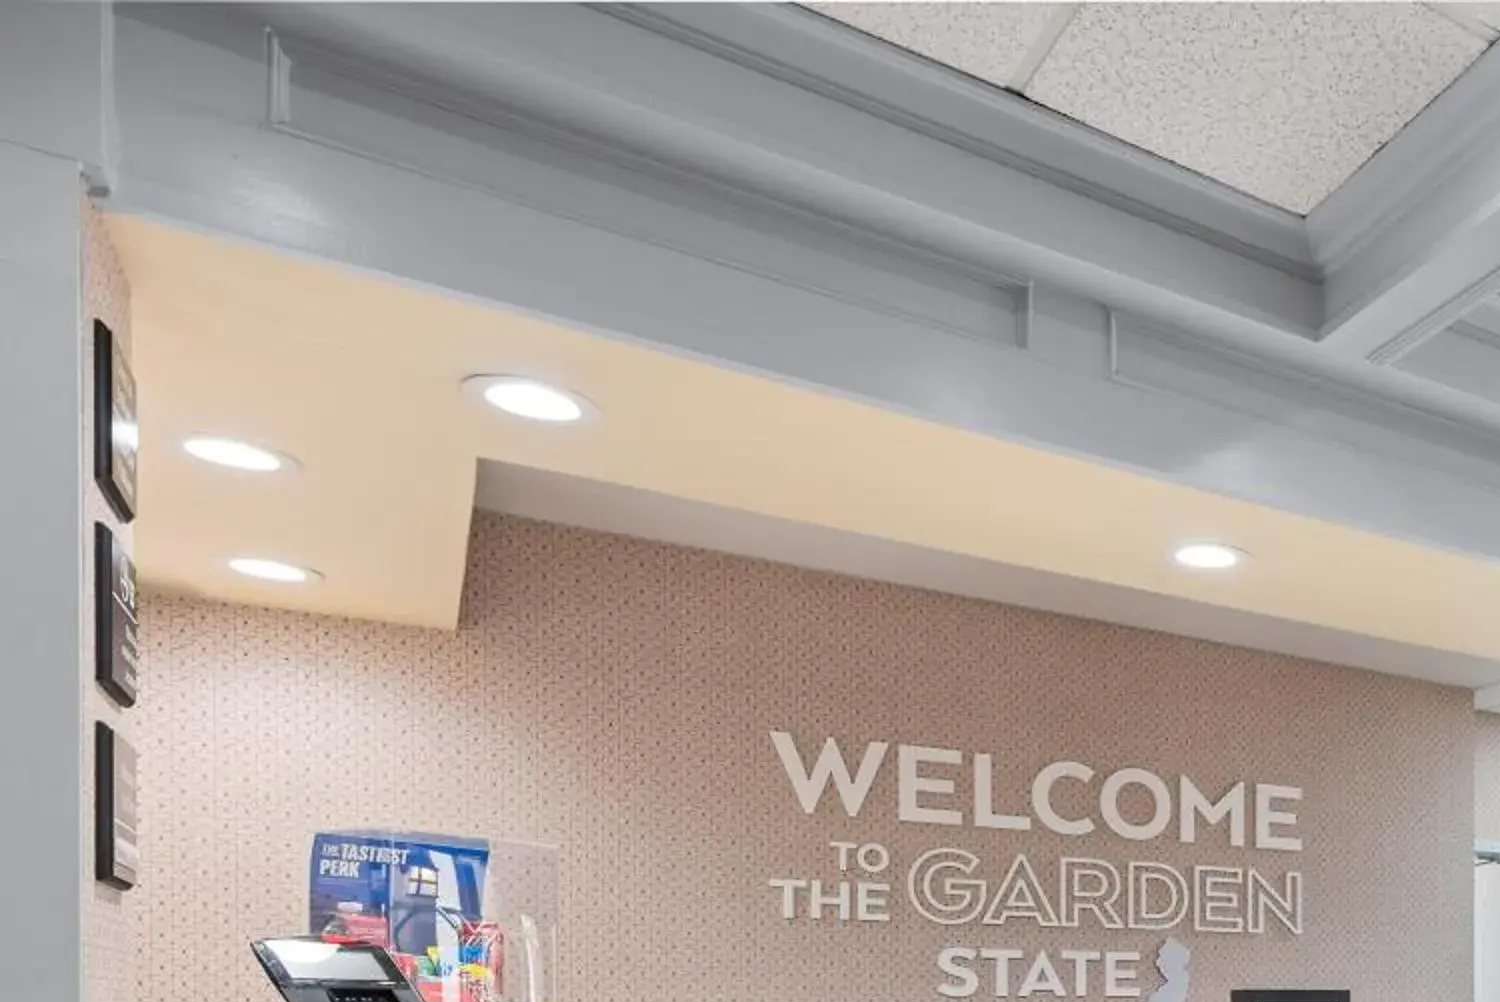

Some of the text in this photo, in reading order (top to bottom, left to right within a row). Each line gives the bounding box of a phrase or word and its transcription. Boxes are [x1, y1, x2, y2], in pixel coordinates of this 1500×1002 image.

[769, 730, 1303, 851] WELCOME
[320, 859, 360, 879] PERK
[829, 841, 890, 873] TO
[769, 847, 1303, 935] THE GARDEN
[936, 947, 1142, 998] STATE
